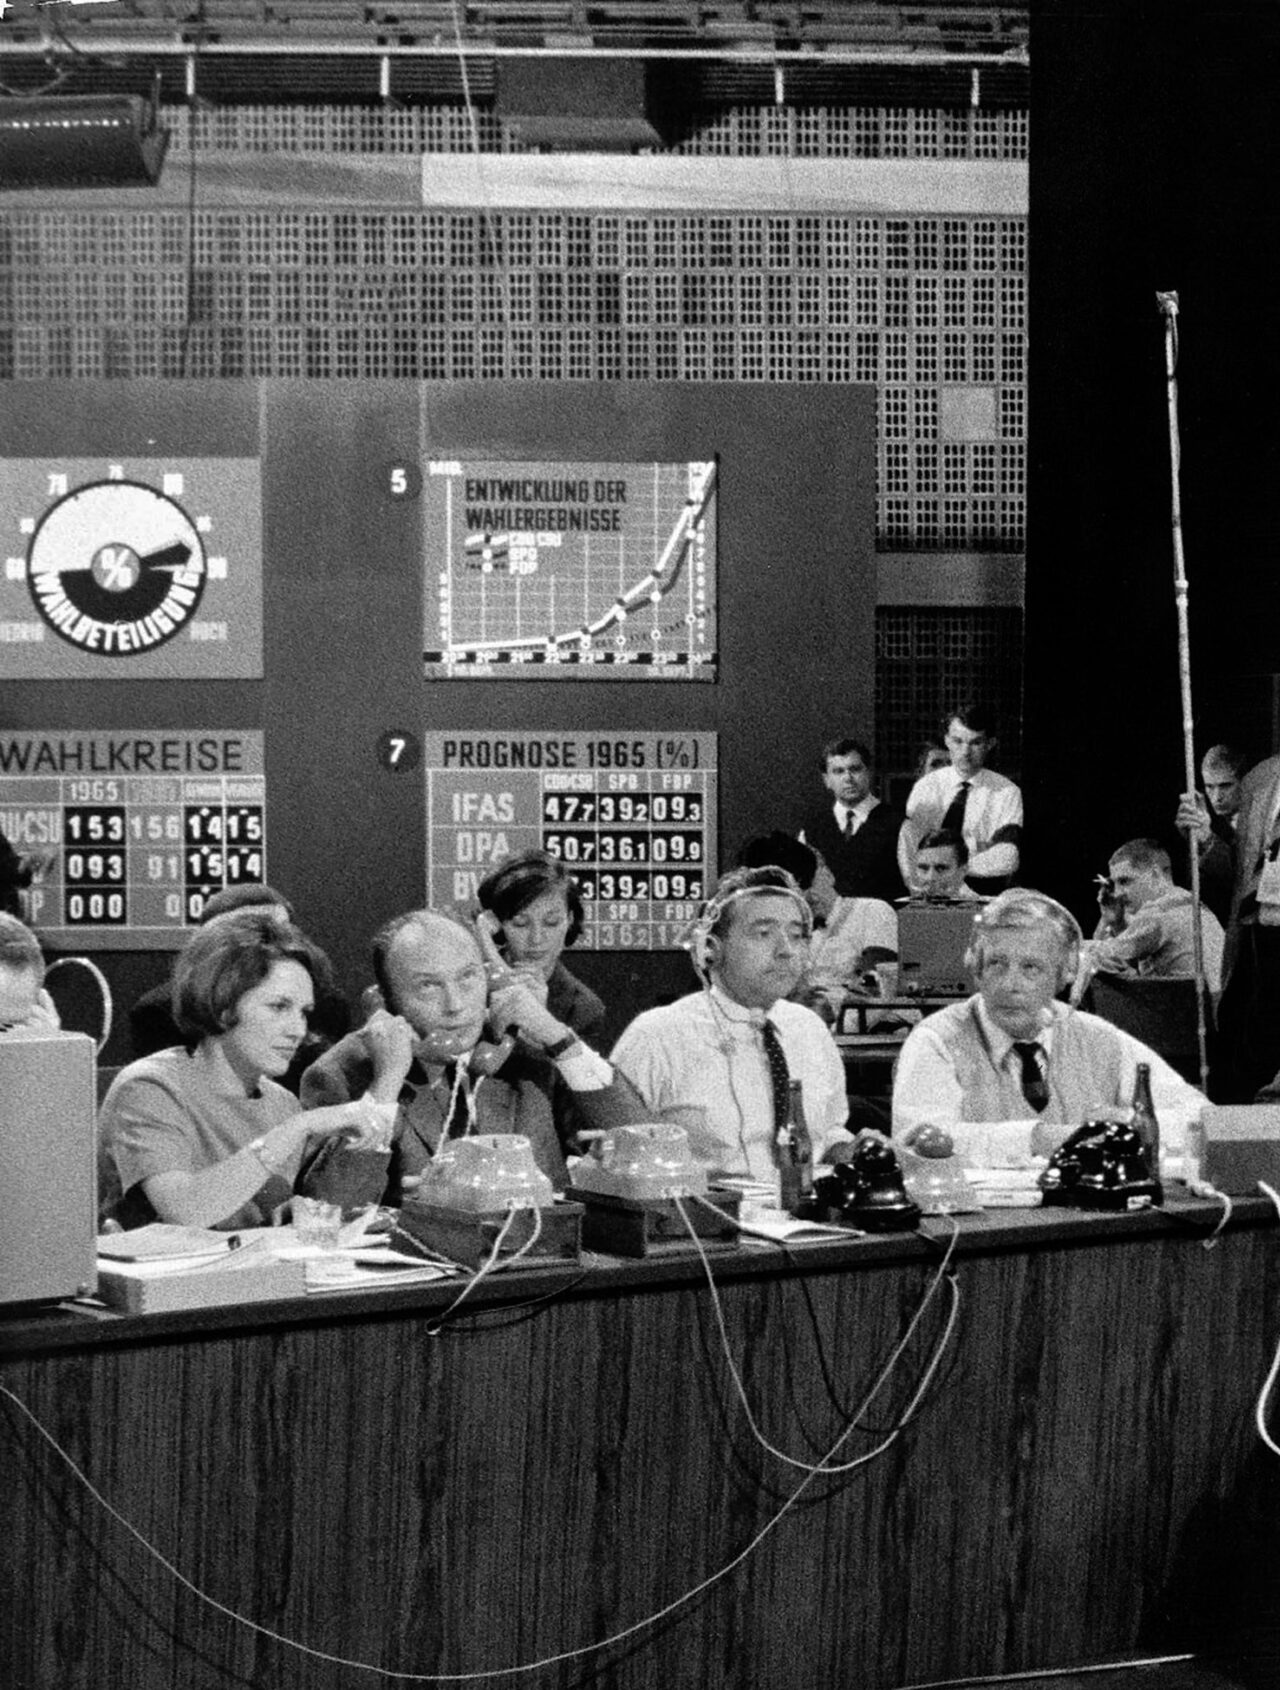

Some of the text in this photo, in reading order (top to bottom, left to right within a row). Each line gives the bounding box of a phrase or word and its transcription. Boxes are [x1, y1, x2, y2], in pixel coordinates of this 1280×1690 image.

[391, 469, 407, 493] 5
[465, 479, 628, 503] ENTWICKLUNG DER
[465, 508, 622, 532] WAHLERGEBNISSE
[0, 740, 242, 772] WAHLKREISE
[389, 738, 406, 763] 7
[443, 738, 700, 769] PROGNOSE 1965 (%)
[70, 781, 118, 801] 1965
[452, 792, 516, 822] IFAS
[68, 815, 123, 839] 153
[68, 854, 123, 879] 093
[69, 894, 123, 919] 000
[189, 894, 205, 919] 0
